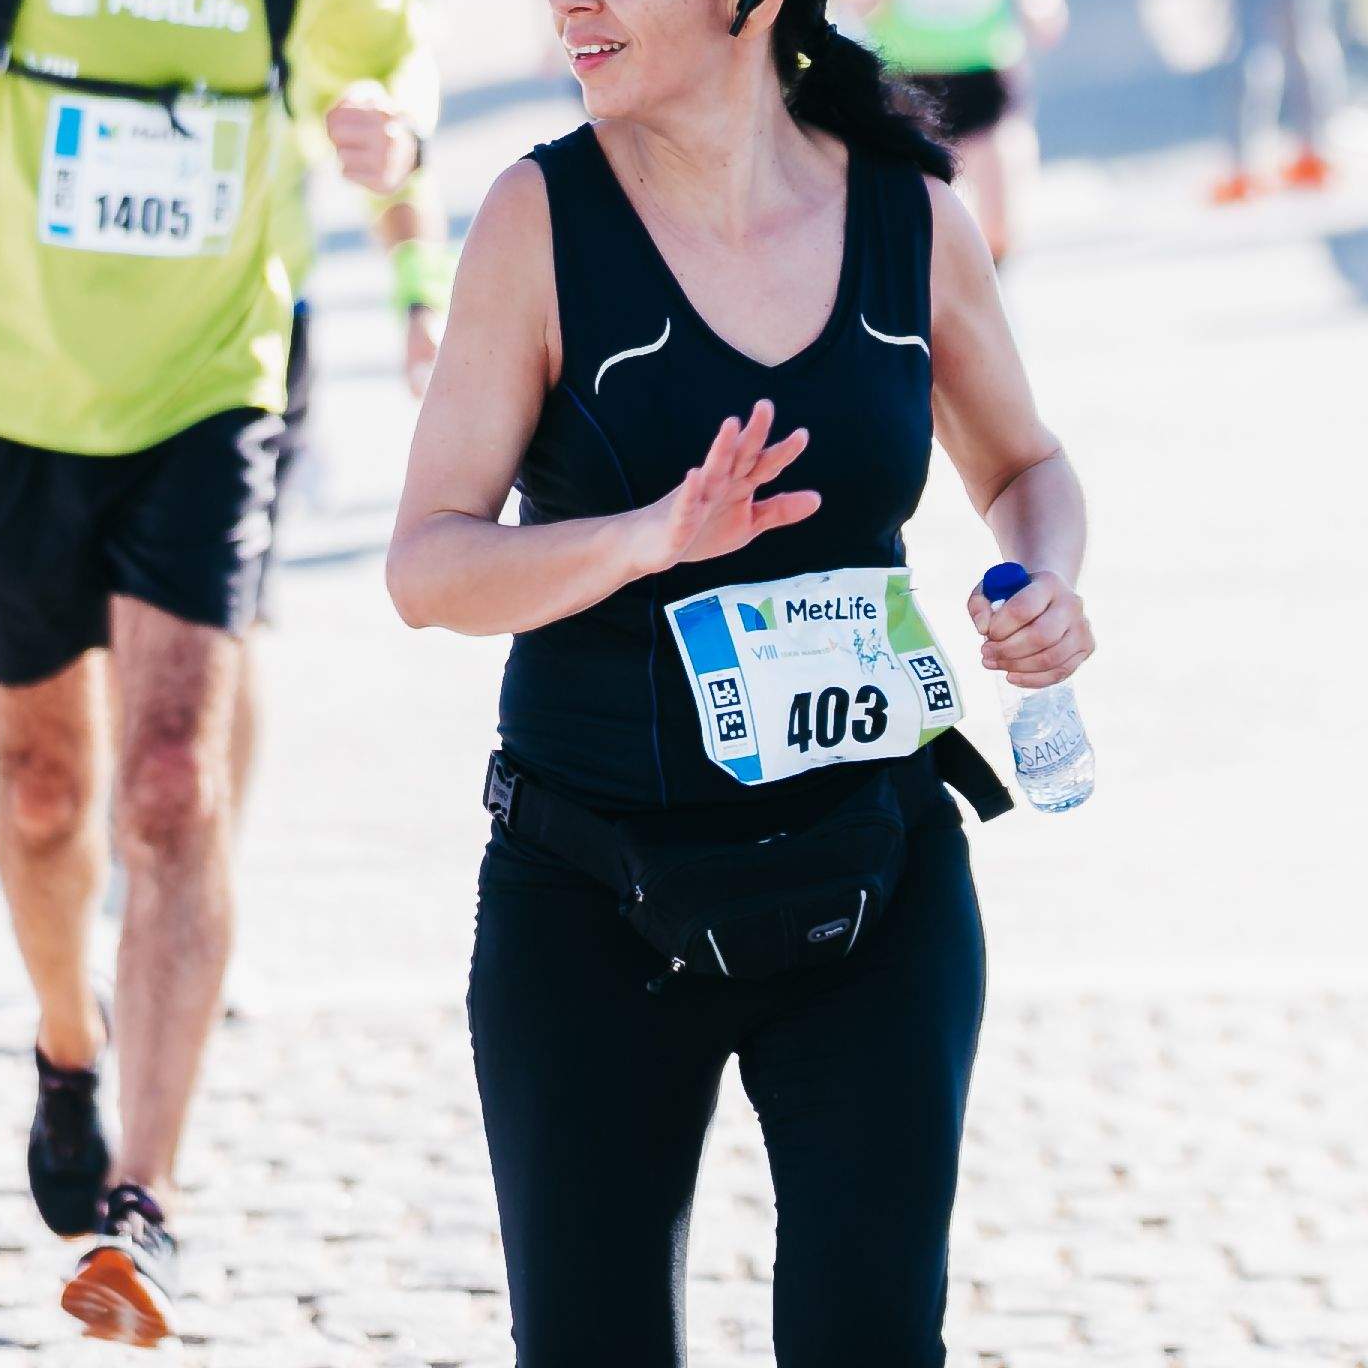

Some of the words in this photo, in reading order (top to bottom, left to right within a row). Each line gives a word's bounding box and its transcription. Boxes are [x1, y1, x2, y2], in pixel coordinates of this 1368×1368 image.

[95, 193, 191, 239] 1405
[785, 596, 877, 624] MetLife
[750, 643, 779, 661] VIII
[786, 683, 889, 753] 403
